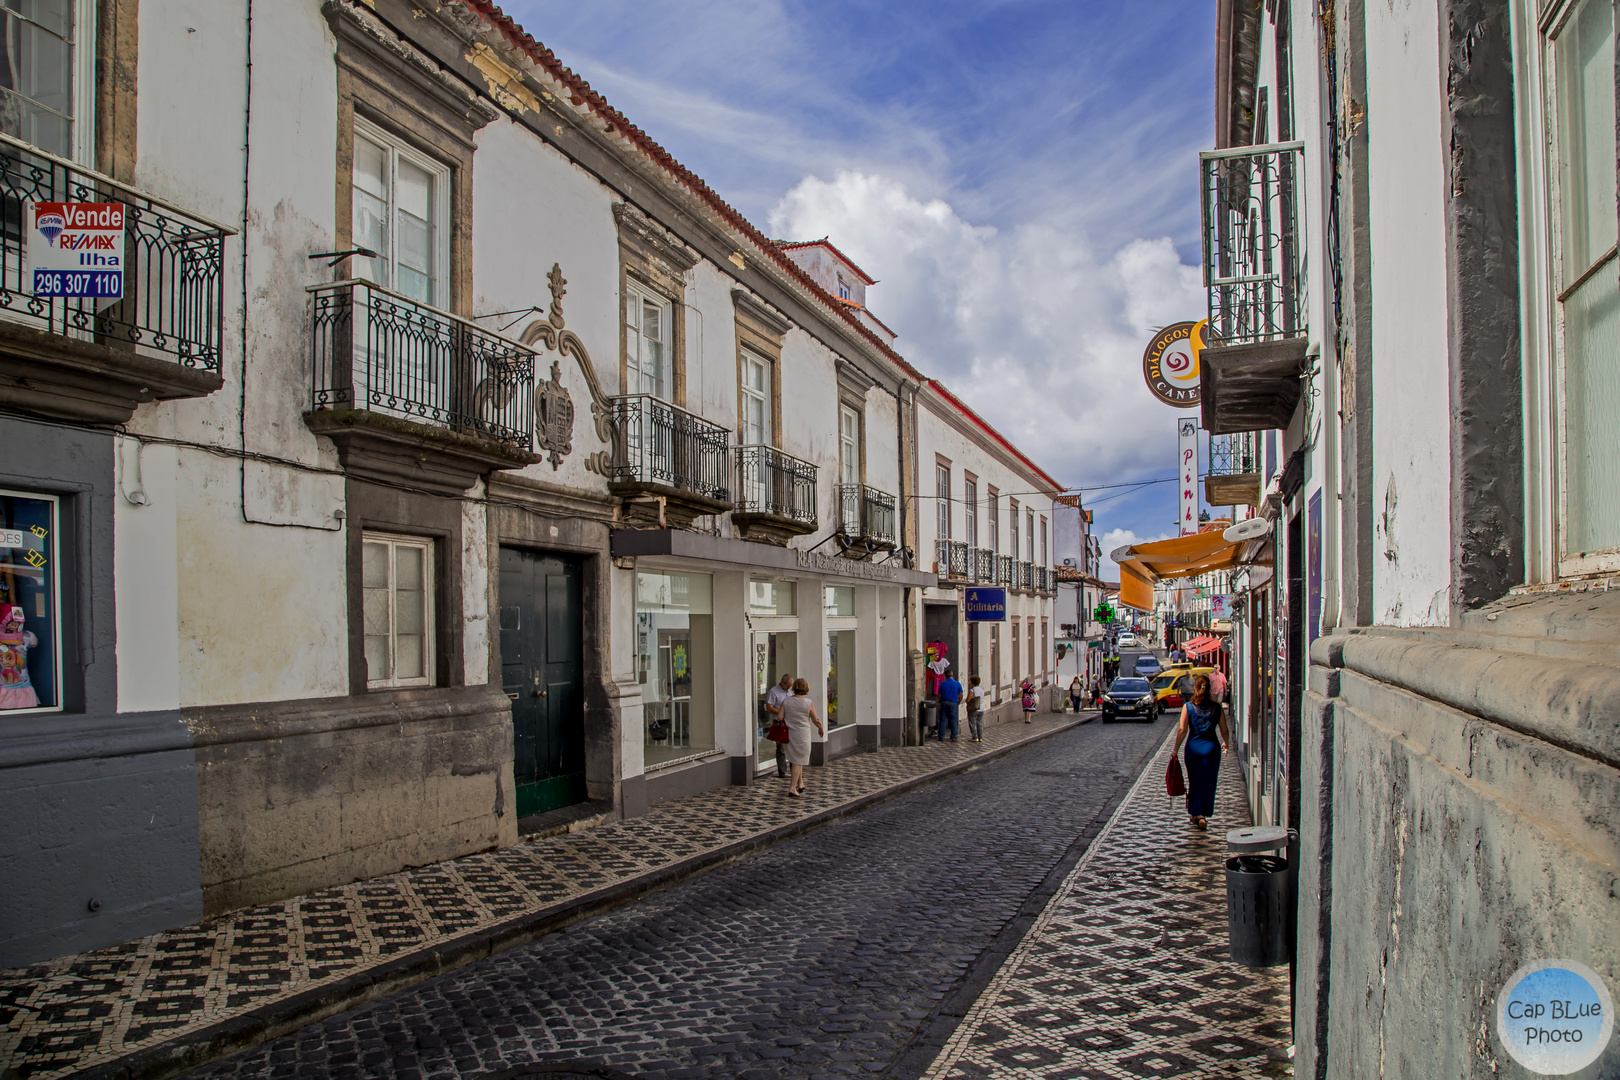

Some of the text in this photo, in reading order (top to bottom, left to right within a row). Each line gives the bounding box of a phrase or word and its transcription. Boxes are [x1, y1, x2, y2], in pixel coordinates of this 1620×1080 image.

[62, 205, 121, 226] Vende
[60, 233, 116, 250] RE/MAX
[80, 253, 119, 265] Ilha
[37, 273, 119, 294] 296 307 110
[1148, 328, 1189, 379] DIÁLOGOS
[1156, 382, 1201, 400] CANE
[1184, 449, 1193, 521] Pink
[970, 592, 978, 601] A
[967, 602, 1004, 611] Utilitária
